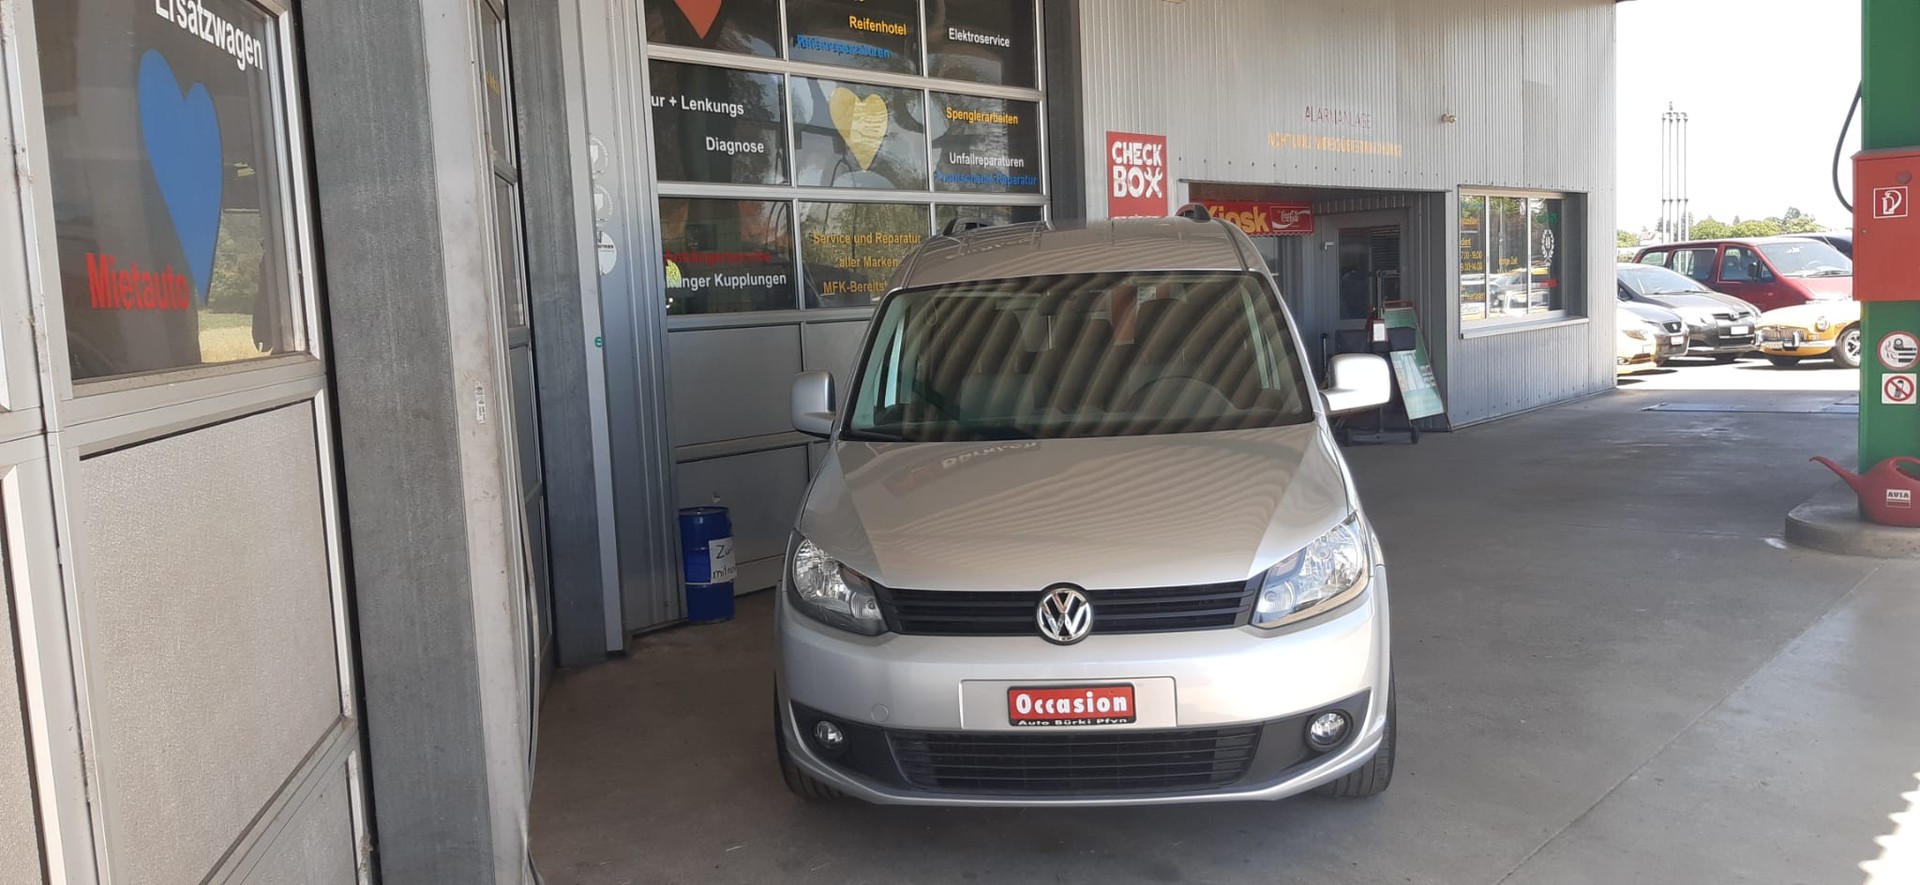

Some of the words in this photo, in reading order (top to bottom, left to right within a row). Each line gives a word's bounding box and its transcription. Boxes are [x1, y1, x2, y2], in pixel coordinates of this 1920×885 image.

[849, 15, 908, 36] Reifenhotel
[948, 27, 1010, 48] Elektroservice
[668, 96, 678, 107] +
[681, 95, 744, 117] Lenkungs
[946, 106, 1019, 125] Spenglerarbeiten
[706, 136, 764, 155] Diagnose
[1112, 141, 1162, 167] CHECK
[949, 151, 1025, 168] Unfallreparaturen
[1113, 165, 1163, 198] BOX
[813, 232, 850, 245] Service
[854, 232, 873, 244] und
[875, 232, 922, 246] Reparatur
[839, 257, 861, 268] aller
[863, 256, 898, 268] Marken
[86, 252, 190, 311] Mietauto
[714, 272, 787, 290] Kupplungen
[1037, 588, 1092, 642] VW
[1016, 691, 1127, 715] Occasion
[1055, 718, 1092, 726] Bürki
